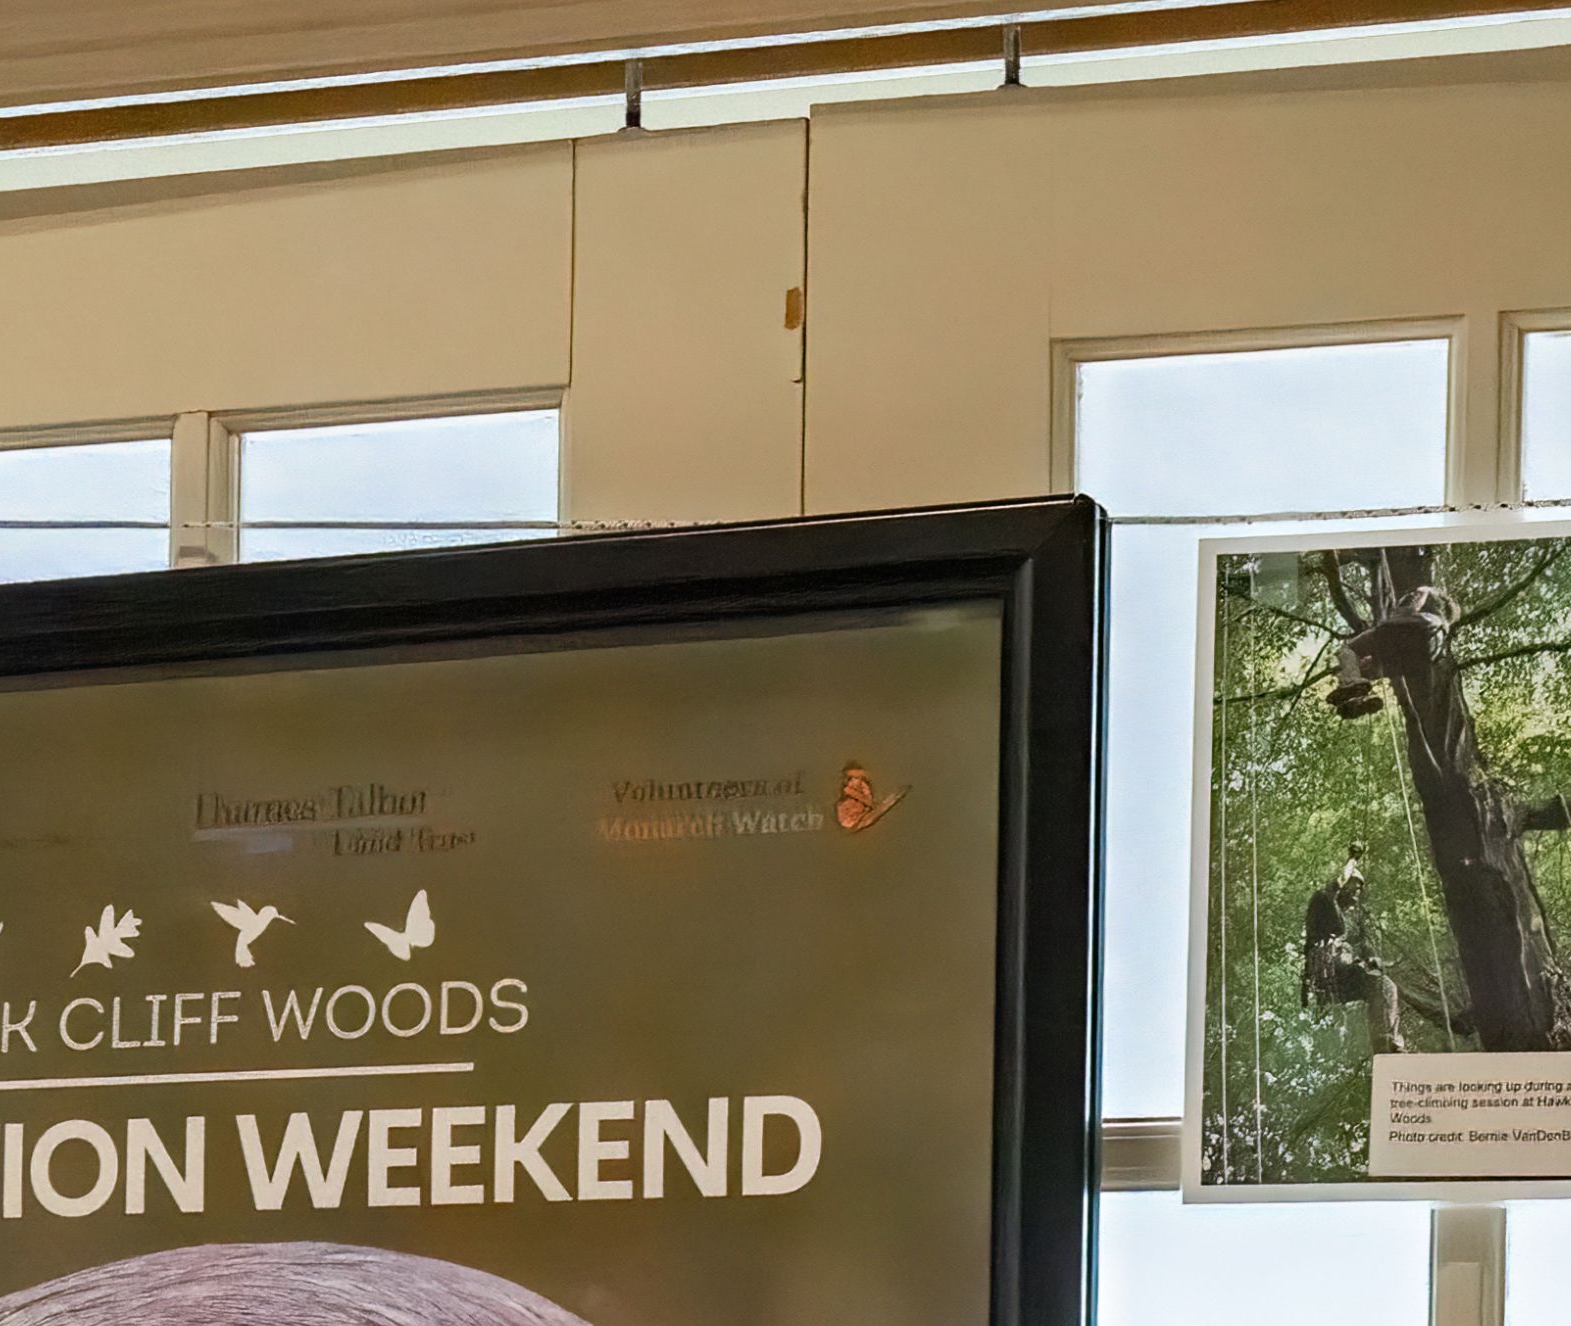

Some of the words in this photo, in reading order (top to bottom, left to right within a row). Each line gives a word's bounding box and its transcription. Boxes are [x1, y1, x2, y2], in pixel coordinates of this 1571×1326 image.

[59, 992, 241, 1051] CLIFF
[262, 979, 530, 1042] WOODS
[1392, 1081, 1431, 1093] Things
[1435, 1083, 1454, 1092] are
[1459, 1082, 1502, 1094] looking
[1506, 1082, 1521, 1092] up
[1524, 1082, 1562, 1093] during
[238, 1095, 823, 1210] WEEKEND
